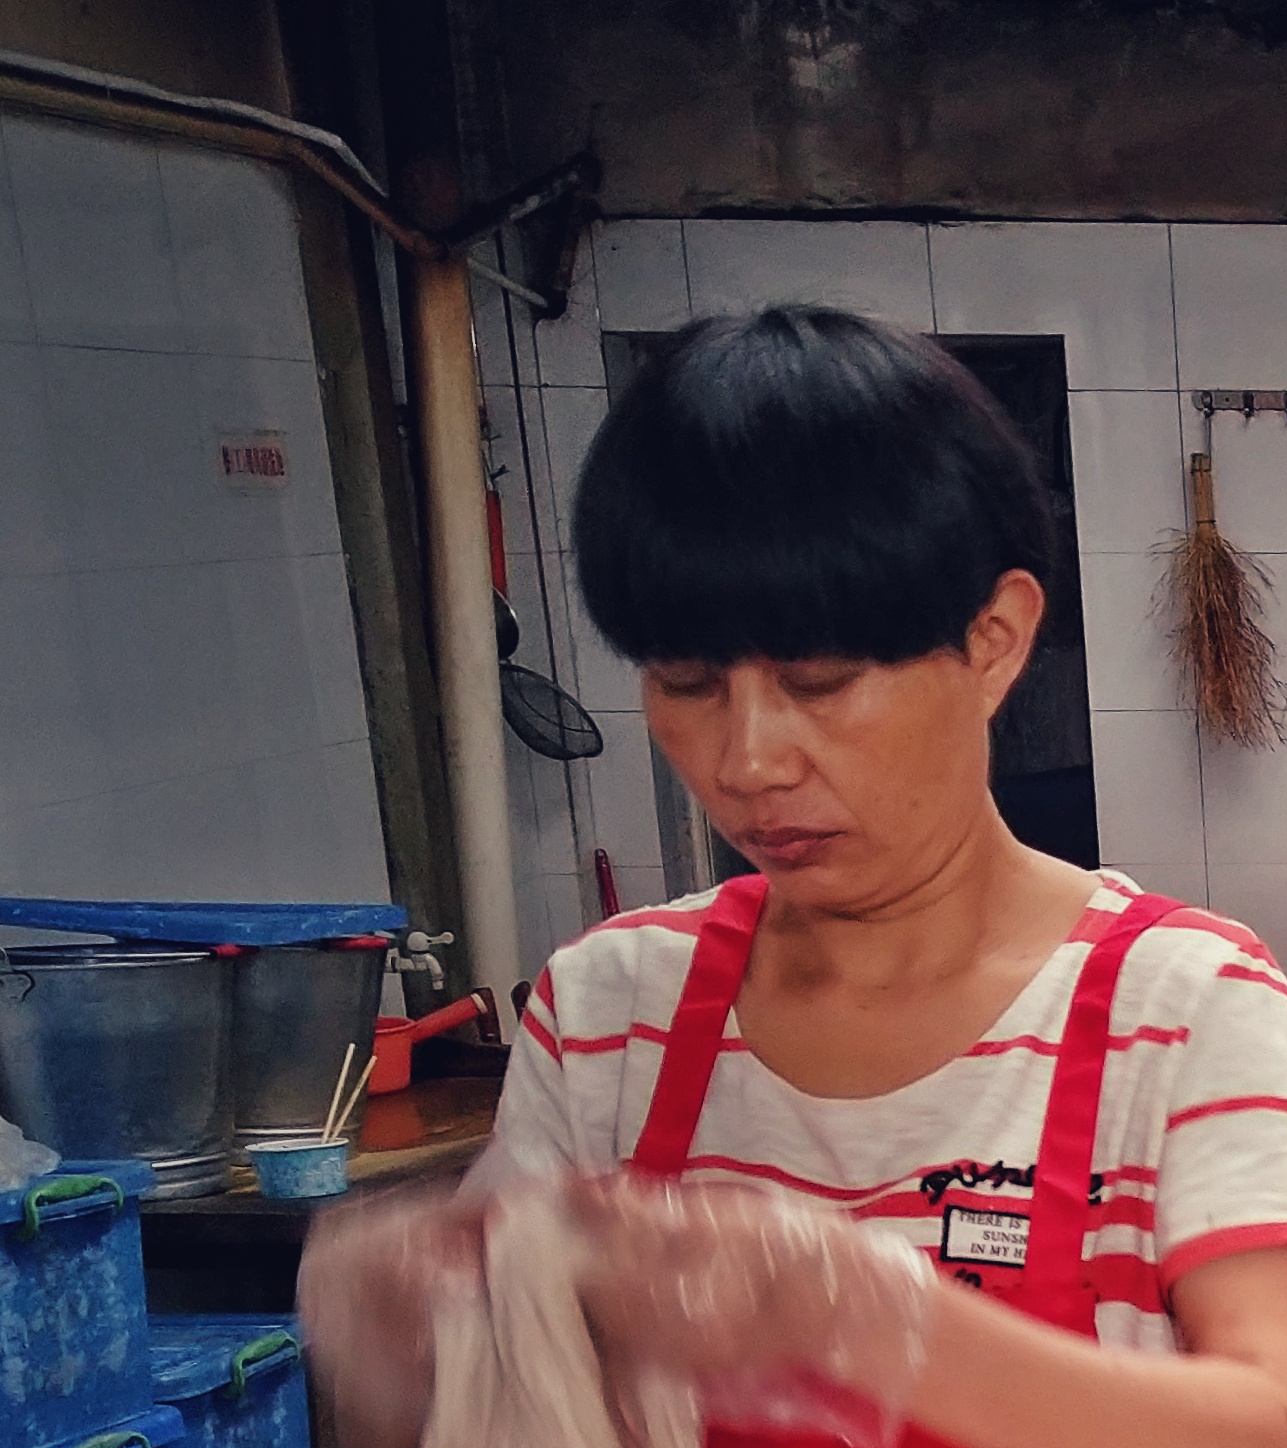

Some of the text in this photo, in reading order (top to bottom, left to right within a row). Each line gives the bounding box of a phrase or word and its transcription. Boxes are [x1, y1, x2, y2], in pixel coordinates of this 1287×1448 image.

[960, 1211, 1022, 1230] THERE IS
[970, 1243, 986, 1255] IN
[990, 1244, 1010, 1257] MY
